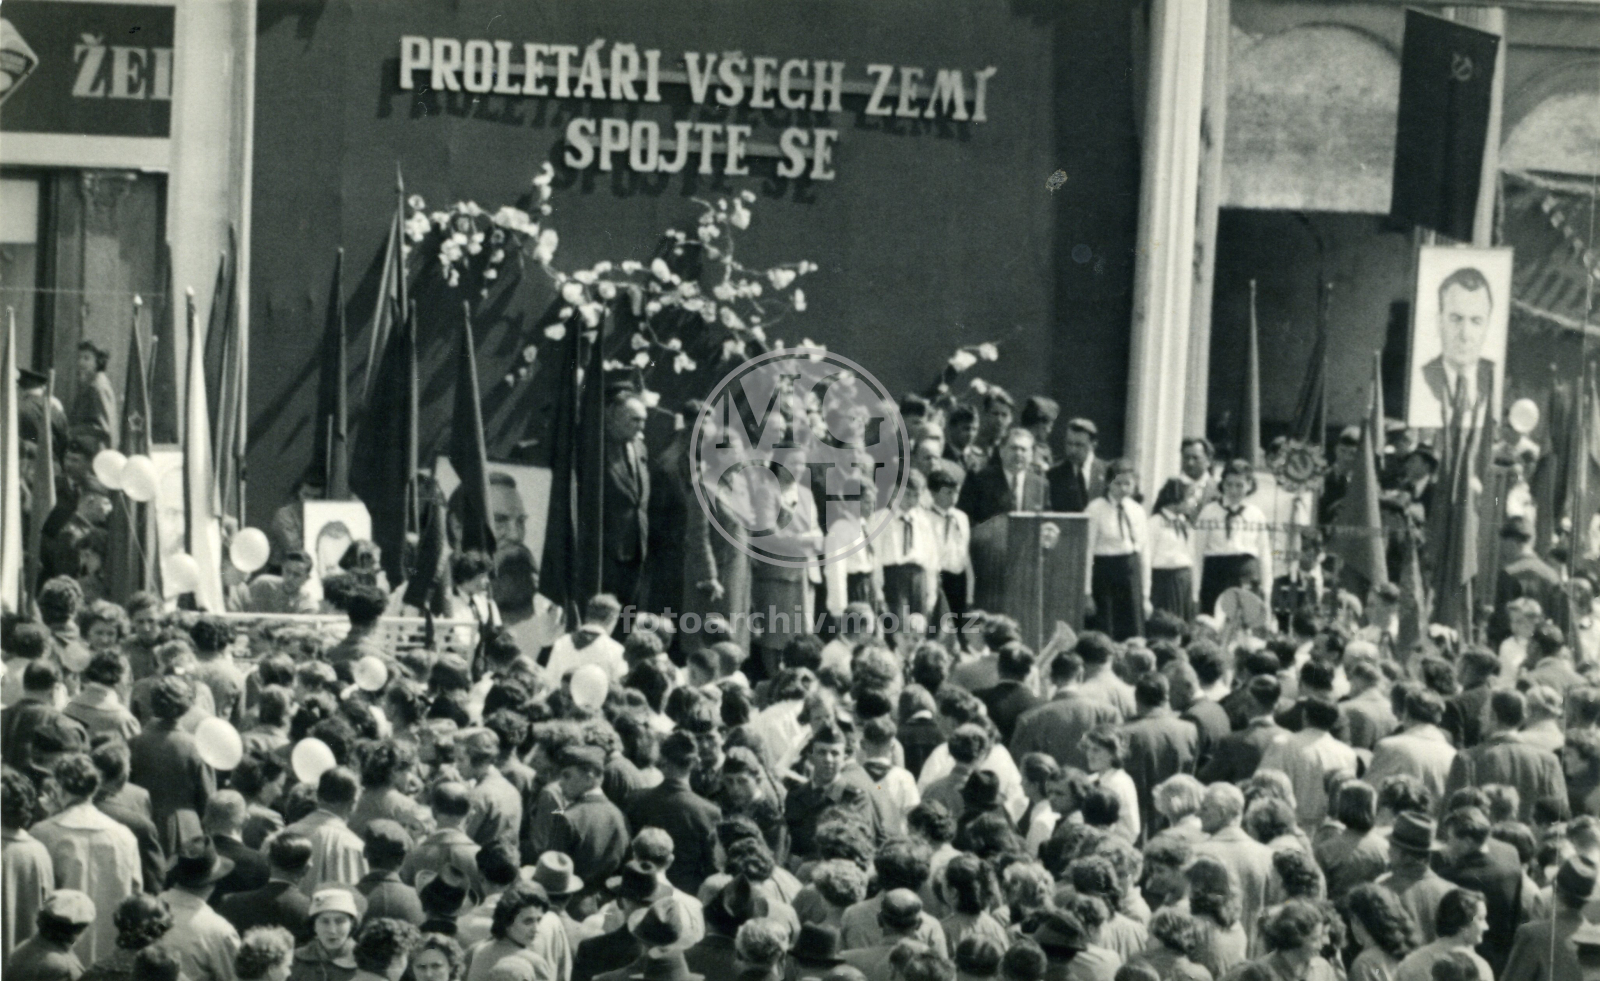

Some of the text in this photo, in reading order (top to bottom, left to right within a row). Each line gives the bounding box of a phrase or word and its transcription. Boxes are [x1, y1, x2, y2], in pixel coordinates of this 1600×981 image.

[400, 35, 997, 122] PROLETÁŘI VŠECH ZEMÍ
[564, 117, 838, 181] SPOJTE SE
